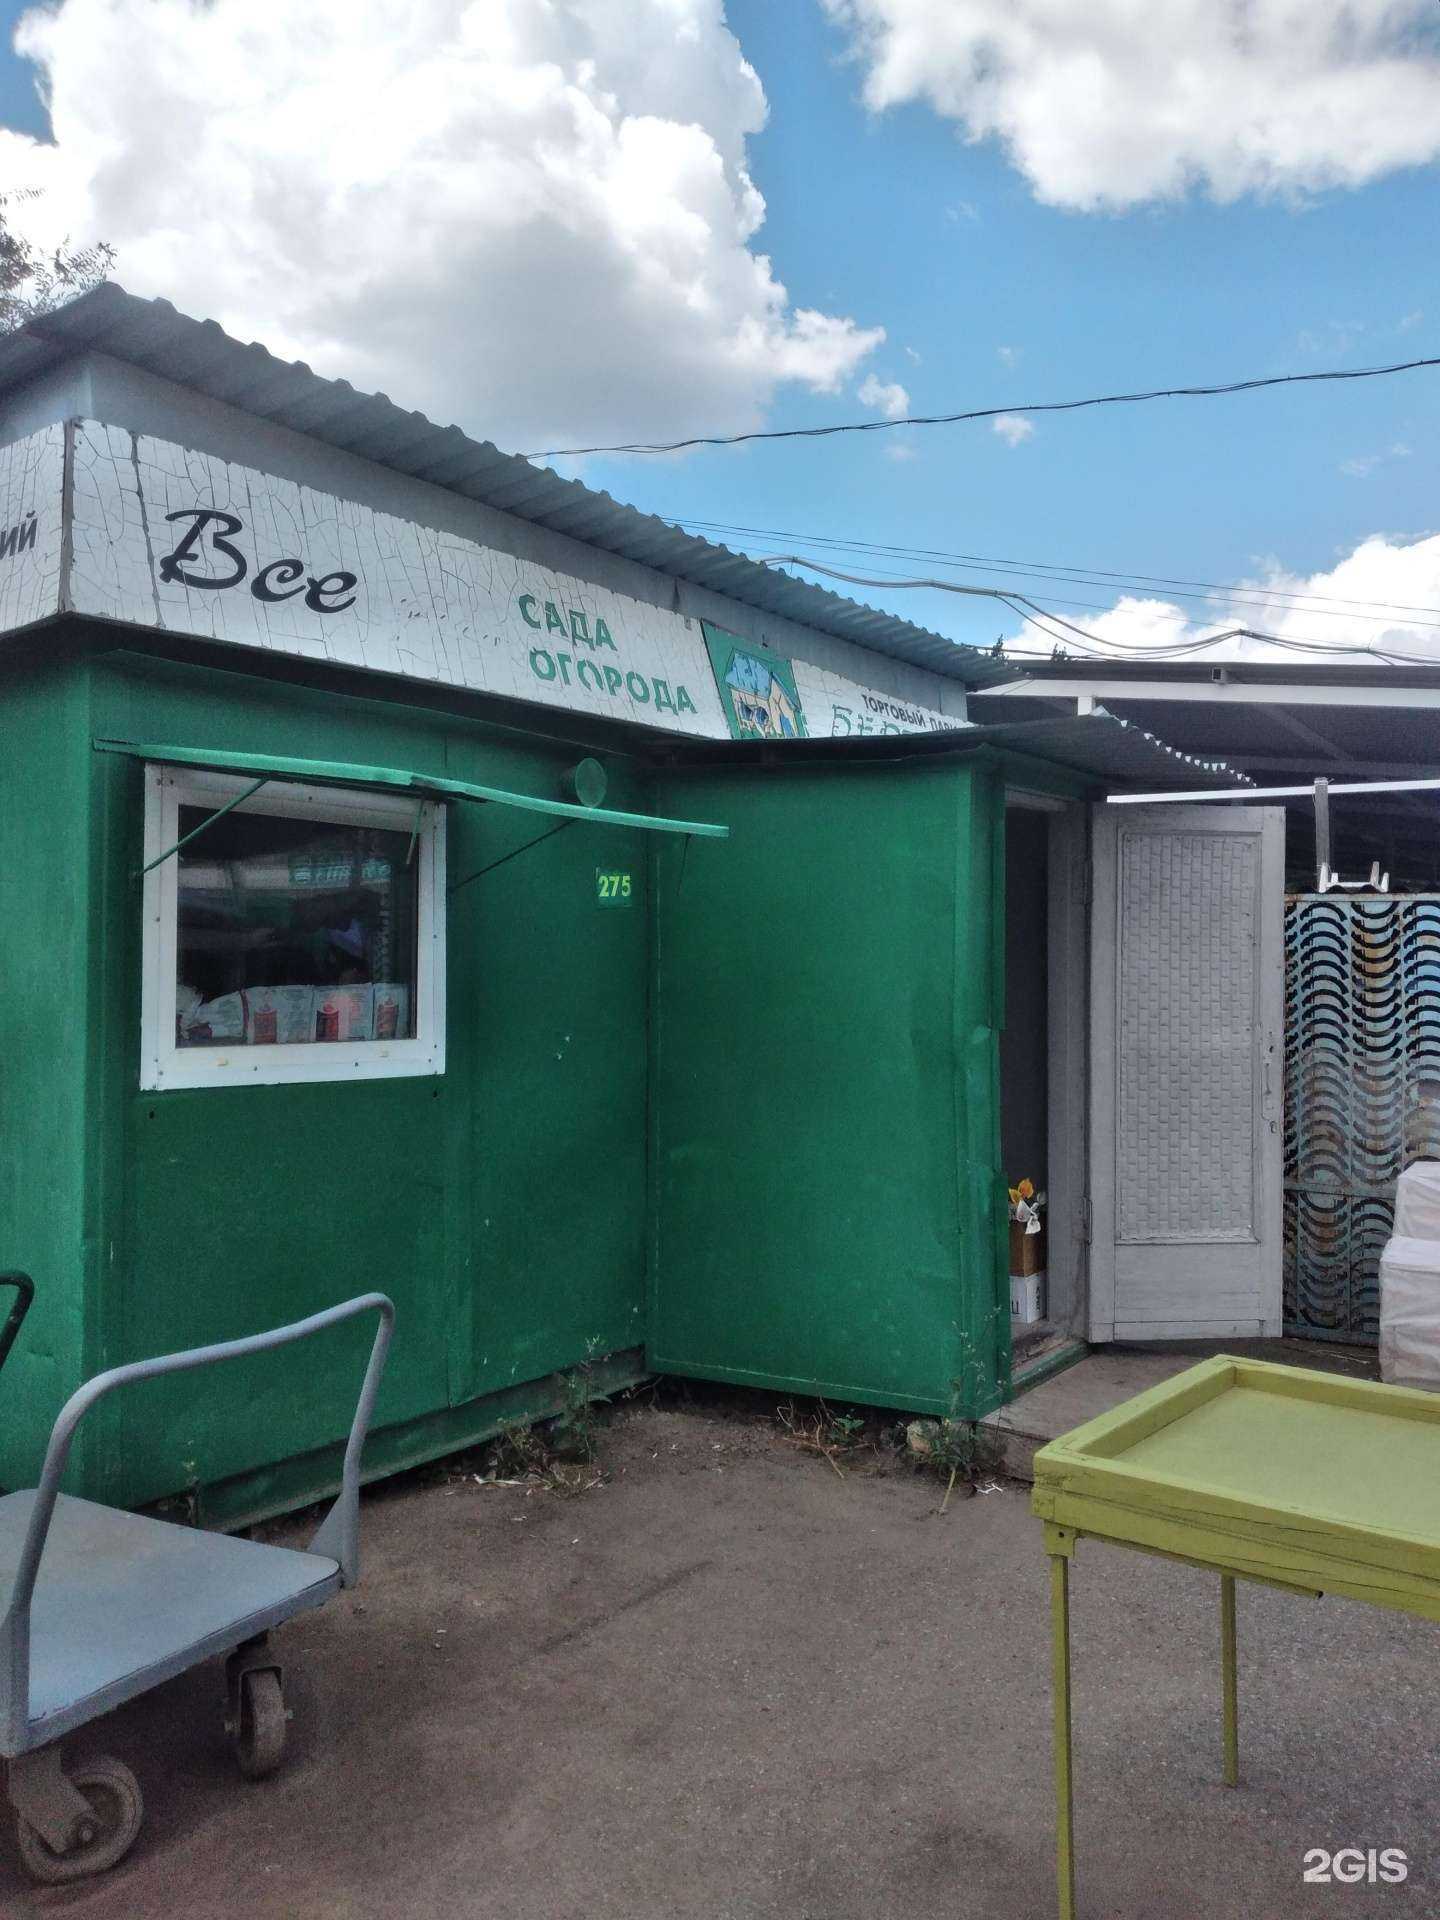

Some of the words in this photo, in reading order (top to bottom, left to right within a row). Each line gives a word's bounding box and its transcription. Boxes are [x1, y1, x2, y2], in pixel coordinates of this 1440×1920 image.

[159, 509, 359, 614] Все
[518, 593, 618, 652] САДА
[528, 647, 698, 716] ОГОРОДА
[861, 694, 927, 729] ТОРГОВЫЙ
[598, 875, 632, 897] 275
